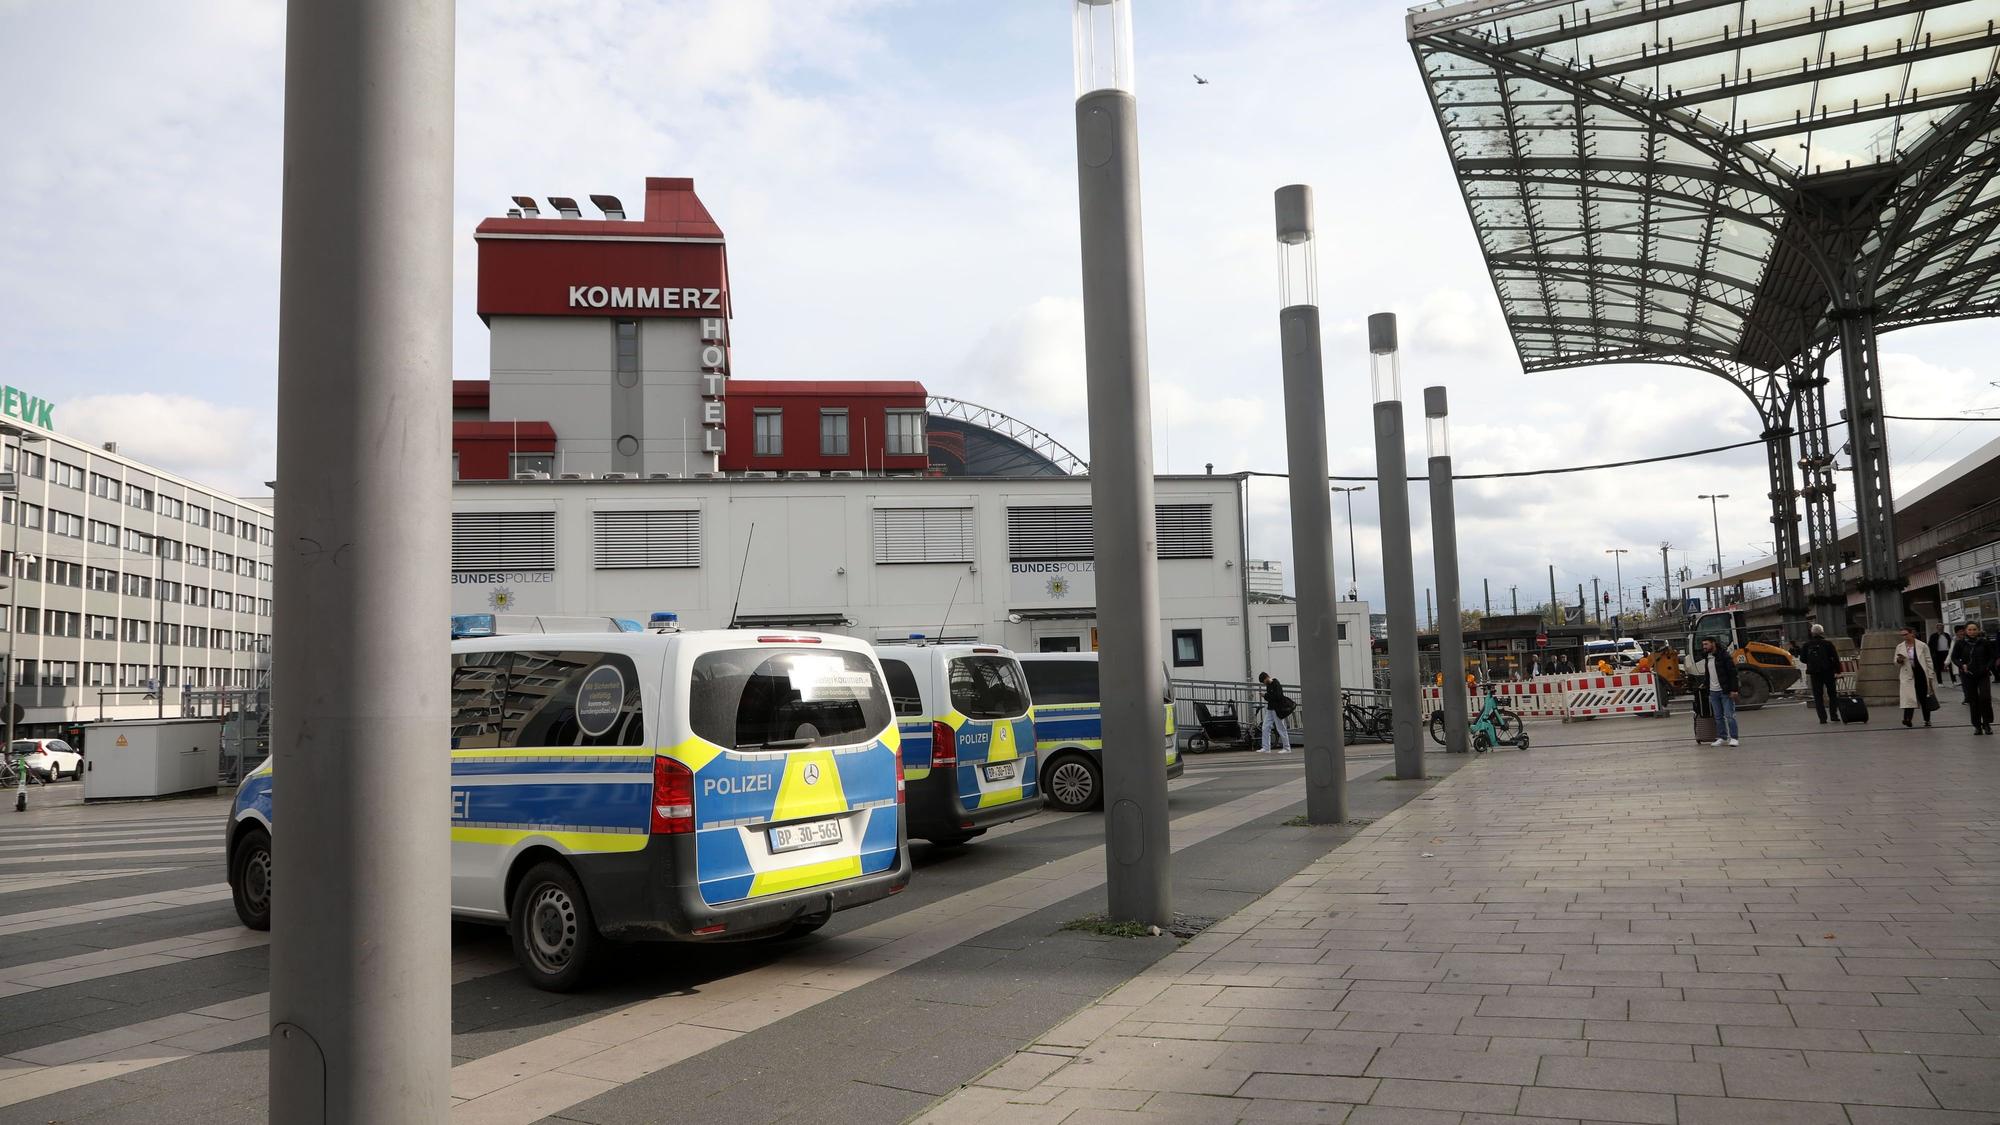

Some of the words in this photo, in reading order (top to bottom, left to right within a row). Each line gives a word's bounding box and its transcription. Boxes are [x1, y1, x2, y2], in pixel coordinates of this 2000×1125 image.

[569, 285, 721, 309] KOMMERZ
[702, 318, 723, 451] HOTEL
[0, 384, 55, 432] EVK
[1011, 562, 1096, 573] BUNDESPOLIZ
[960, 733, 988, 745] POLIZEI
[704, 773, 772, 796] POLIZEI
[777, 829, 792, 846] BP
[798, 822, 838, 843] 30-563
